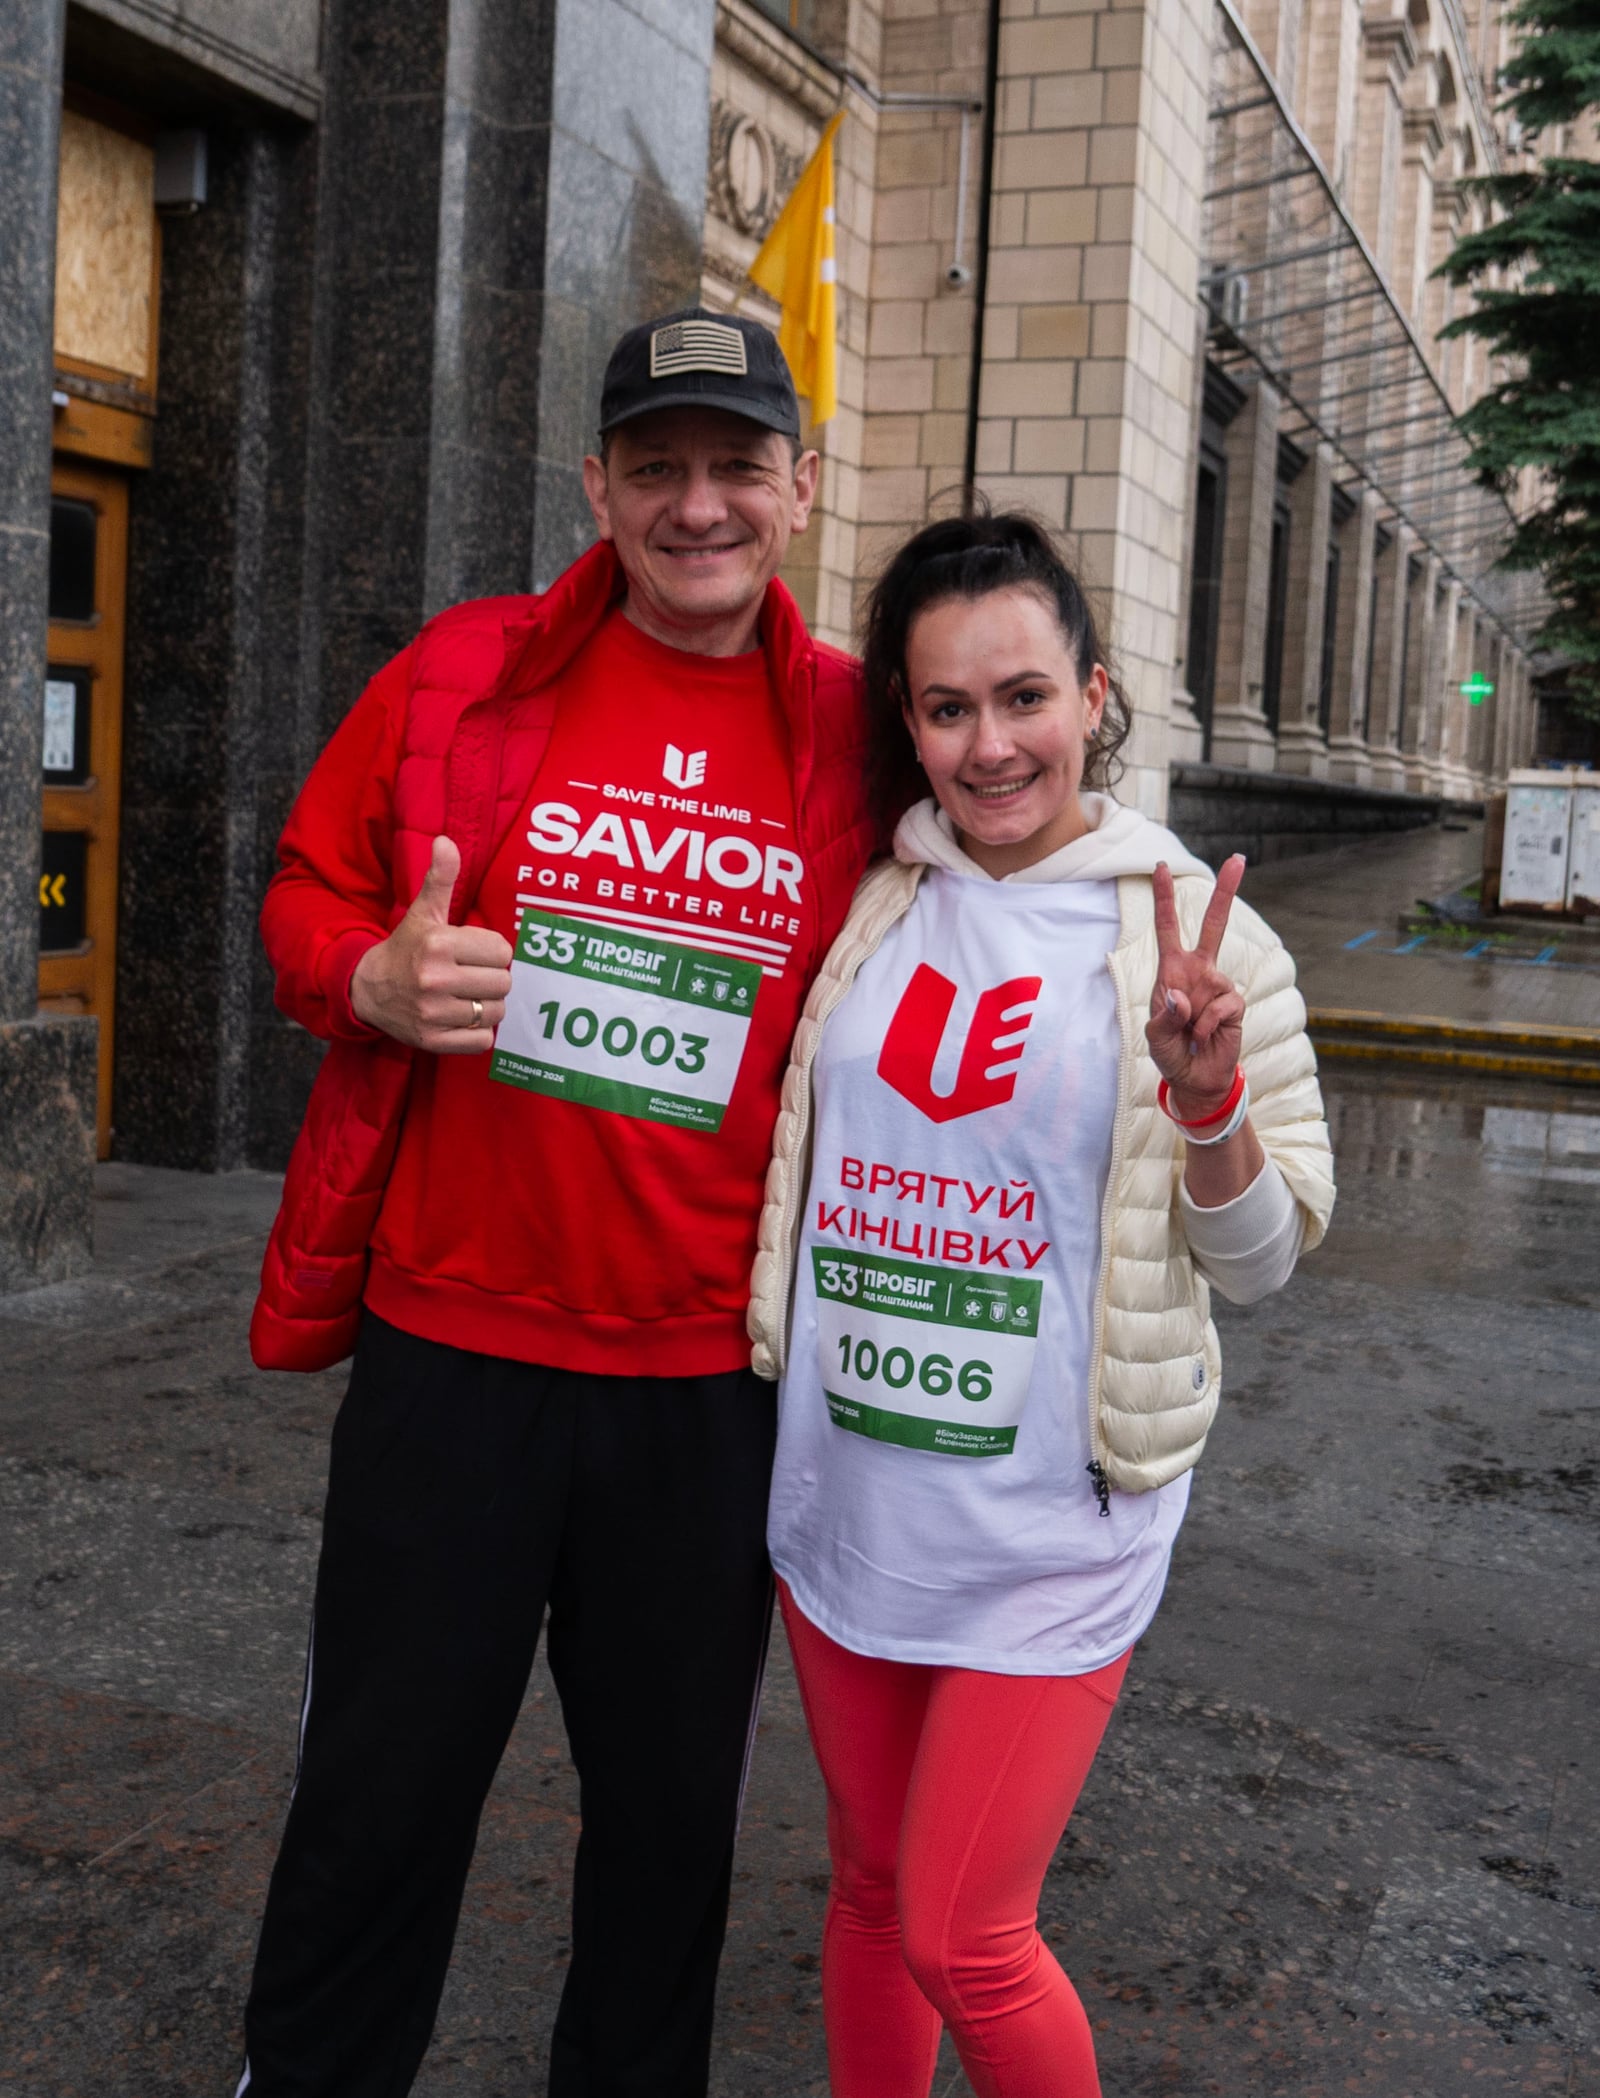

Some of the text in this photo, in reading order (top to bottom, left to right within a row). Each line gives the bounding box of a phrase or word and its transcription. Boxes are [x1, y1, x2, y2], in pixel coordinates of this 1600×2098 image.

[602, 783, 752, 824] SAVE THE LIMB
[526, 801, 804, 904] SAVIOR
[517, 865, 801, 936] FOR BETTER LIFE
[582, 958, 662, 986] ПІД КАШТАНАМИ
[585, 937, 667, 972] ПРОБІГ
[538, 1000, 710, 1074] 10003
[507, 1060, 542, 1077] ТРАВНЯ
[840, 1156, 1035, 1222] ВРЯТУЙ
[817, 1201, 1051, 1270] КІНЦІВКУ
[862, 1290, 934, 1313] ПІД КАШТАНАМИ
[864, 1268, 937, 1298] ПРОБІГ
[838, 1334, 994, 1402] 10066
